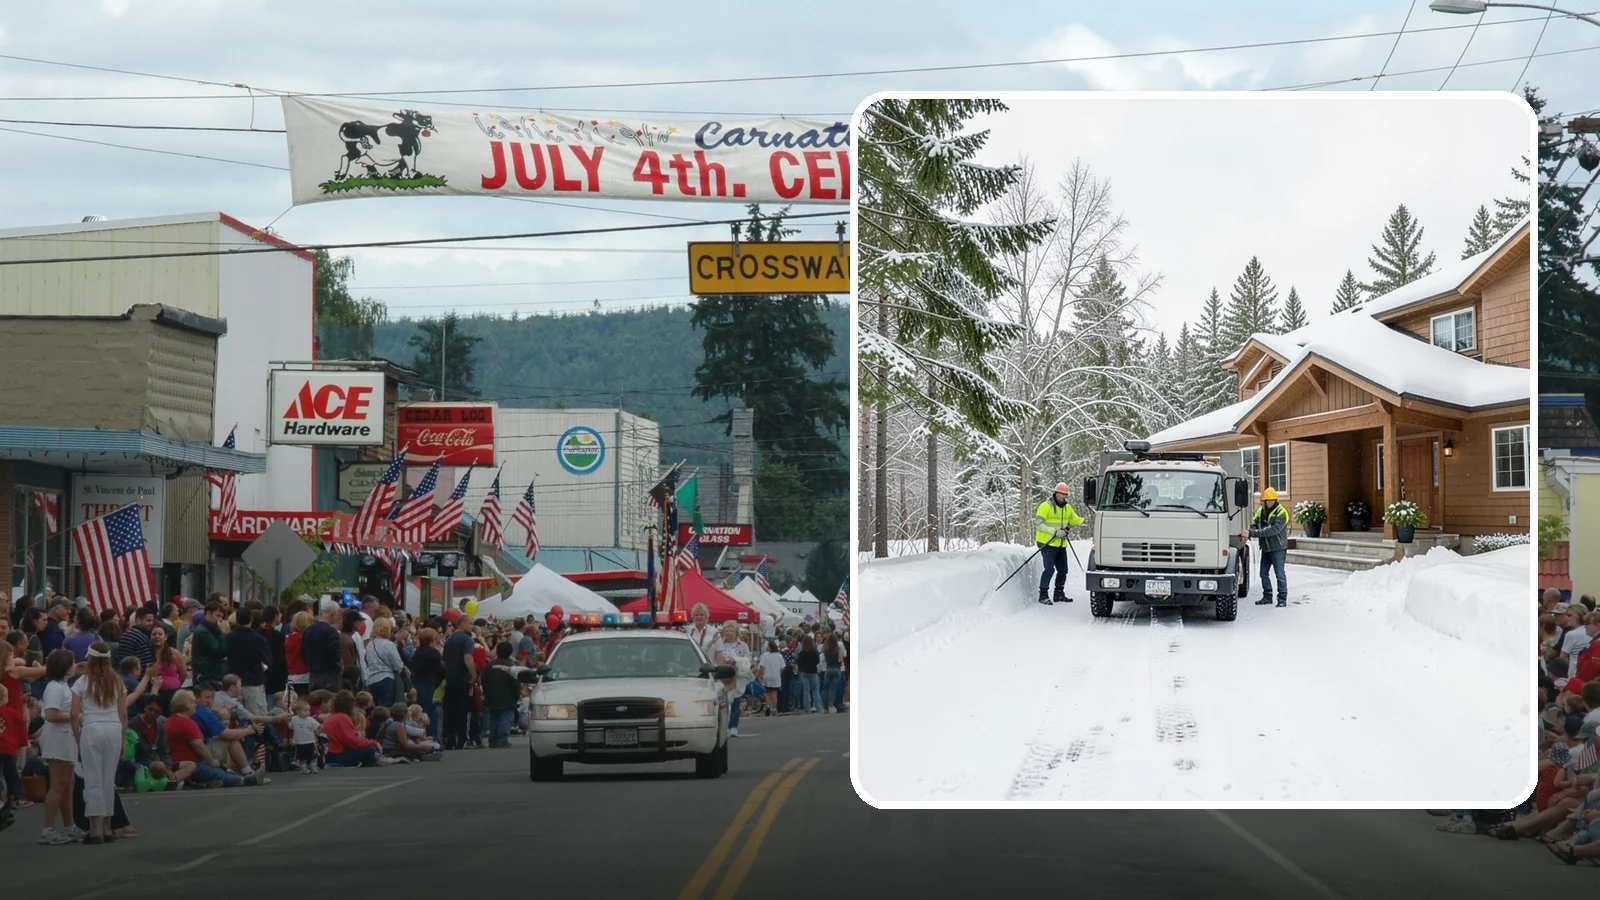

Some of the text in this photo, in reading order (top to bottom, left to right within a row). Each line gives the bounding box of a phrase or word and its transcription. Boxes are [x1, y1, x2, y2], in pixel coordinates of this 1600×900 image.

[481, 141, 605, 193] JULY
[632, 149, 746, 198] 4th.
[696, 254, 850, 280] CROSSWA
[283, 380, 373, 420] ACE
[406, 409, 485, 421] CEDAR LOG
[283, 421, 371, 436] Hardware
[416, 428, 477, 447] Coca-Cola
[353, 467, 385, 479] Simpl
[95, 485, 124, 494] Vincent
[126, 486, 136, 494] de
[137, 486, 155, 495] Paul
[80, 503, 154, 521] THRT
[212, 516, 330, 535] HARDARE
[688, 526, 741, 535] CRNATION
